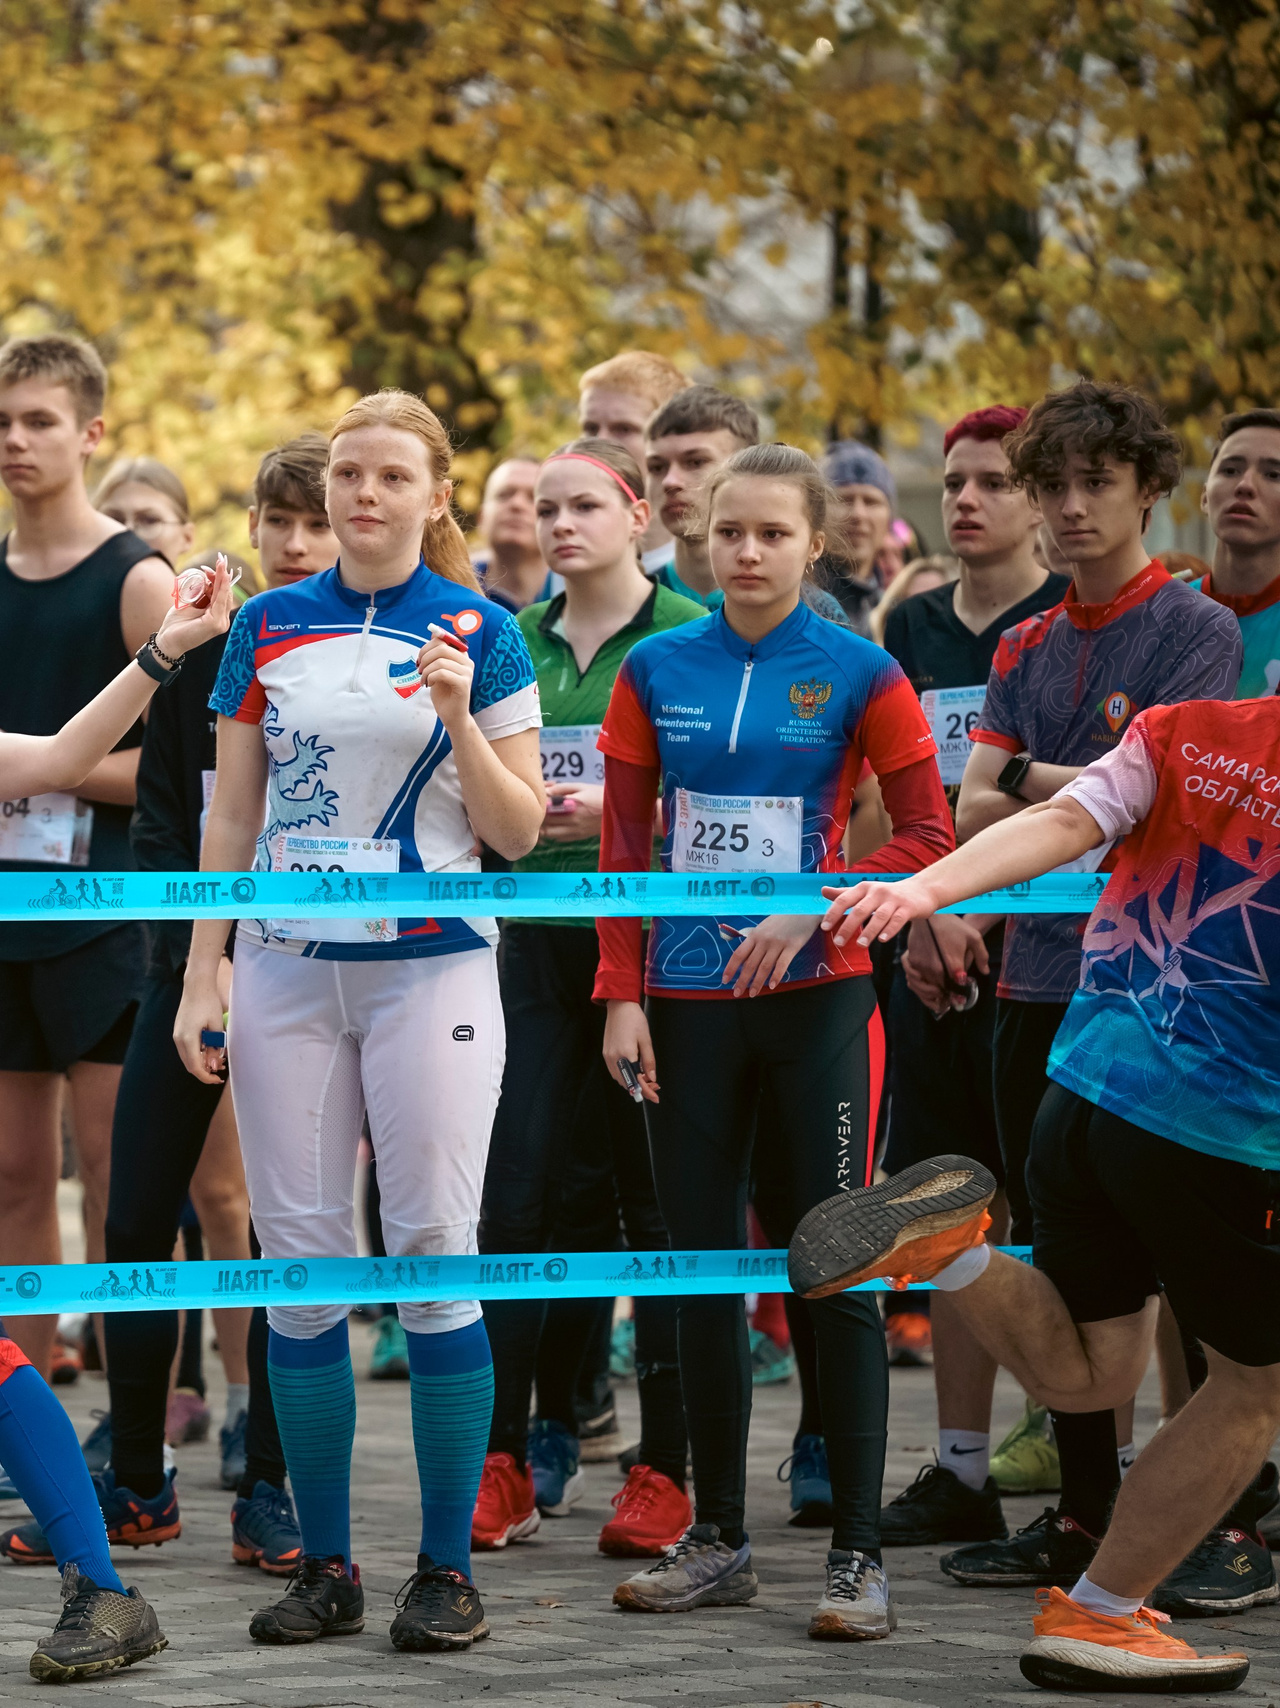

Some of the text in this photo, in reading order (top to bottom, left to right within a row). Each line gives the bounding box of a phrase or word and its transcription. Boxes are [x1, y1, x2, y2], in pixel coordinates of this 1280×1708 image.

[661, 704, 704, 715] National
[655, 717, 712, 731] Orienteering
[788, 719, 822, 728] RUSSIAN
[775, 726, 832, 736] ORIENTEERING
[666, 732, 690, 742] Team
[779, 734, 826, 744] FEDERATION
[723, 799, 751, 809] РОССИИ
[287, 837, 348, 850] ПЕРВЕНСТВО РОССИИ
[691, 820, 774, 857] 225 3
[686, 849, 719, 865] МЖ16
